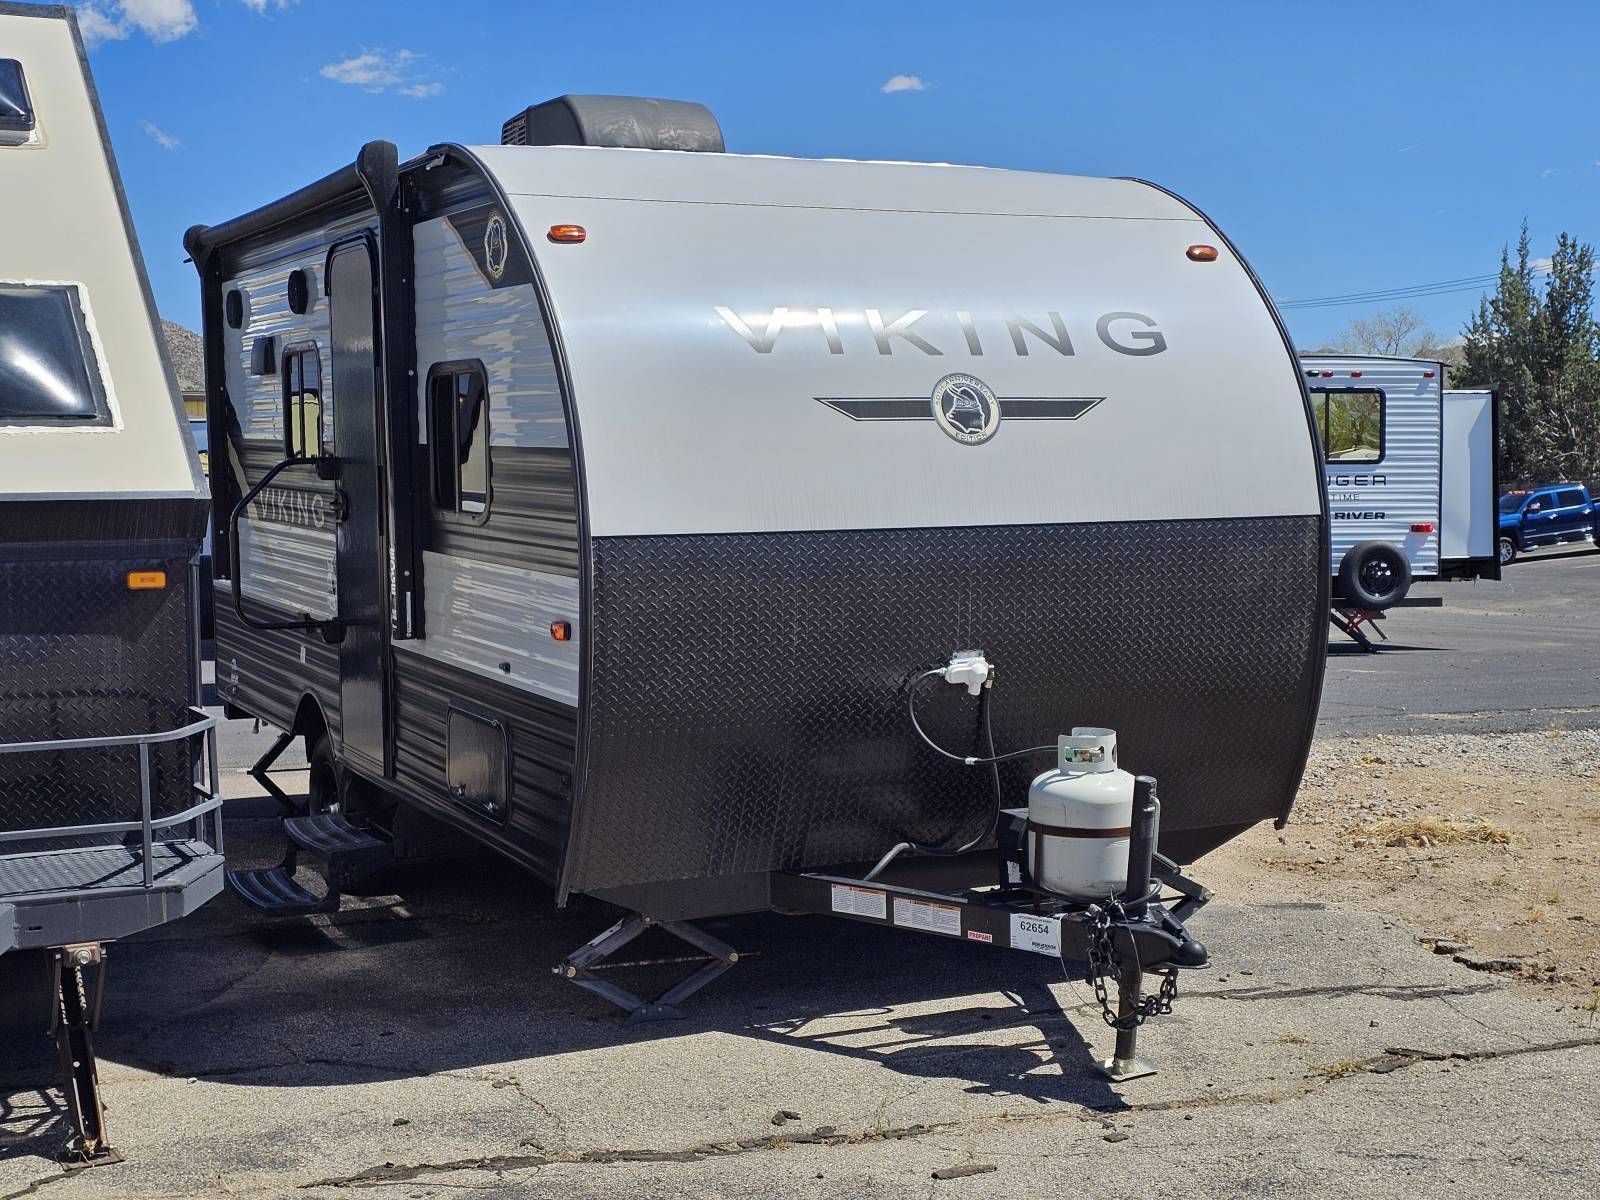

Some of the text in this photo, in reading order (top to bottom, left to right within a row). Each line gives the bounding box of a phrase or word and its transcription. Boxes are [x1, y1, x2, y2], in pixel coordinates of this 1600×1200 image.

[713, 306, 1168, 357] VIKING
[955, 431, 988, 441] EDITION
[1327, 475, 1387, 486] GER
[1331, 493, 1360, 501] TIME
[259, 487, 325, 528] VIKING
[1334, 512, 1386, 520] RIVER
[1020, 921, 1049, 935] 62654
[968, 931, 992, 942] PROPANE
